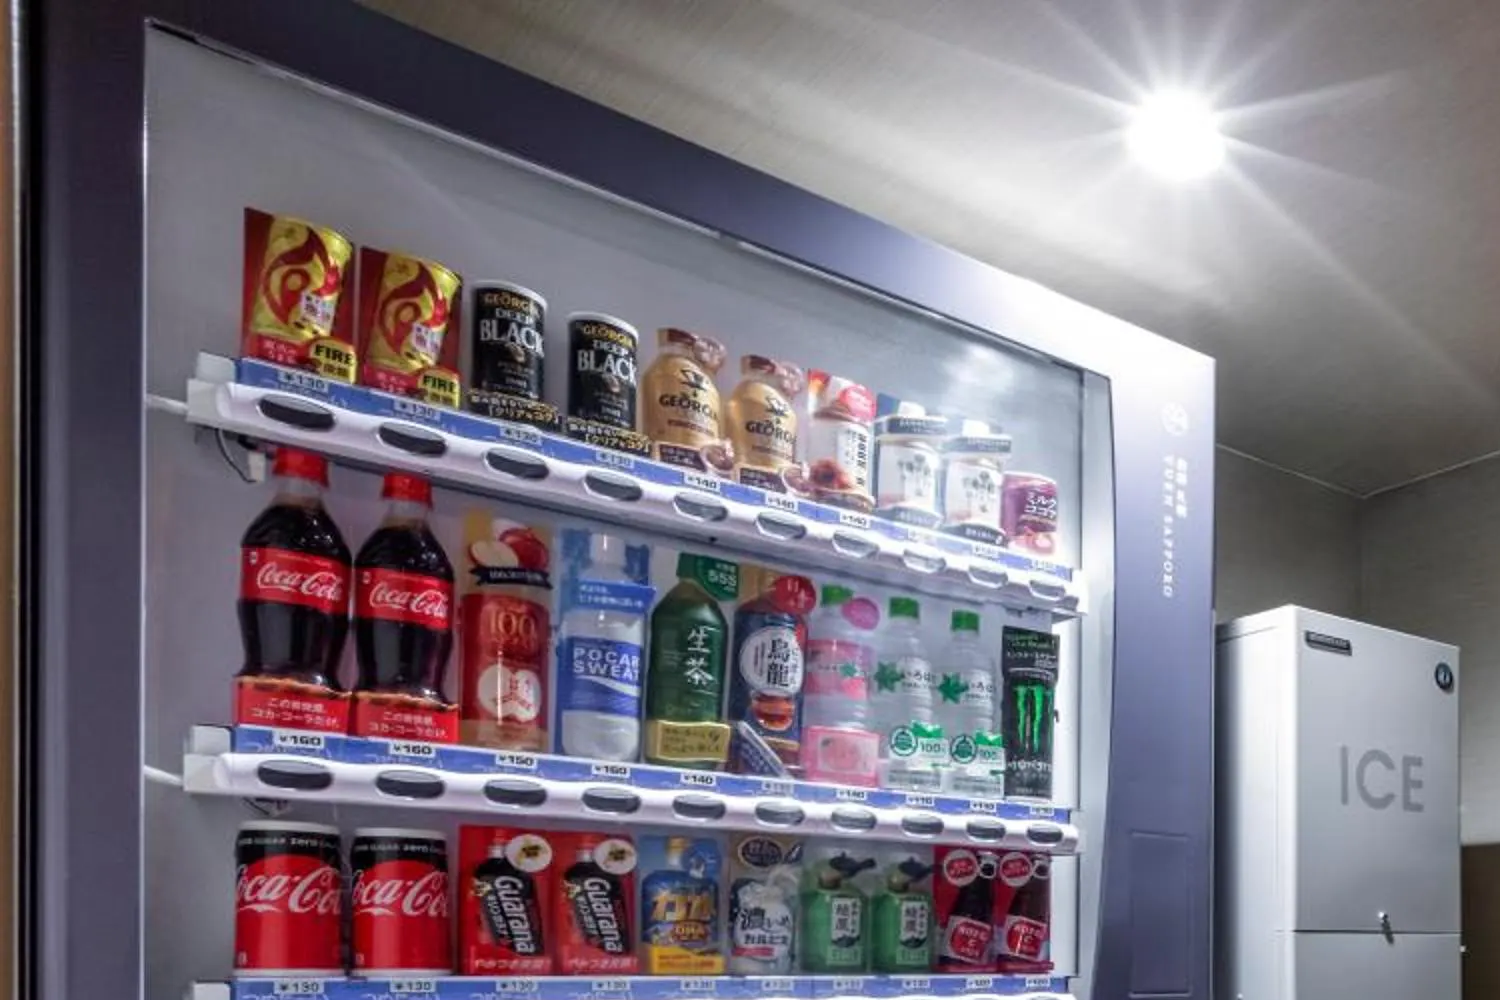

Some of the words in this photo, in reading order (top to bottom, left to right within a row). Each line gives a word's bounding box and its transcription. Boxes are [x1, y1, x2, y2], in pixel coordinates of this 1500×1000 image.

[480, 319, 545, 358] BLACK
[315, 344, 353, 365] FIRE
[423, 374, 456, 393] FIRE
[256, 562, 343, 601] Coca-Cola
[369, 582, 449, 619] Coca-Cola
[572, 647, 640, 669] POCAR
[683, 627, 717, 686] 生茶
[279, 734, 322, 747] ¥160
[394, 744, 433, 756] ¥160
[1339, 744, 1425, 813] ICE
